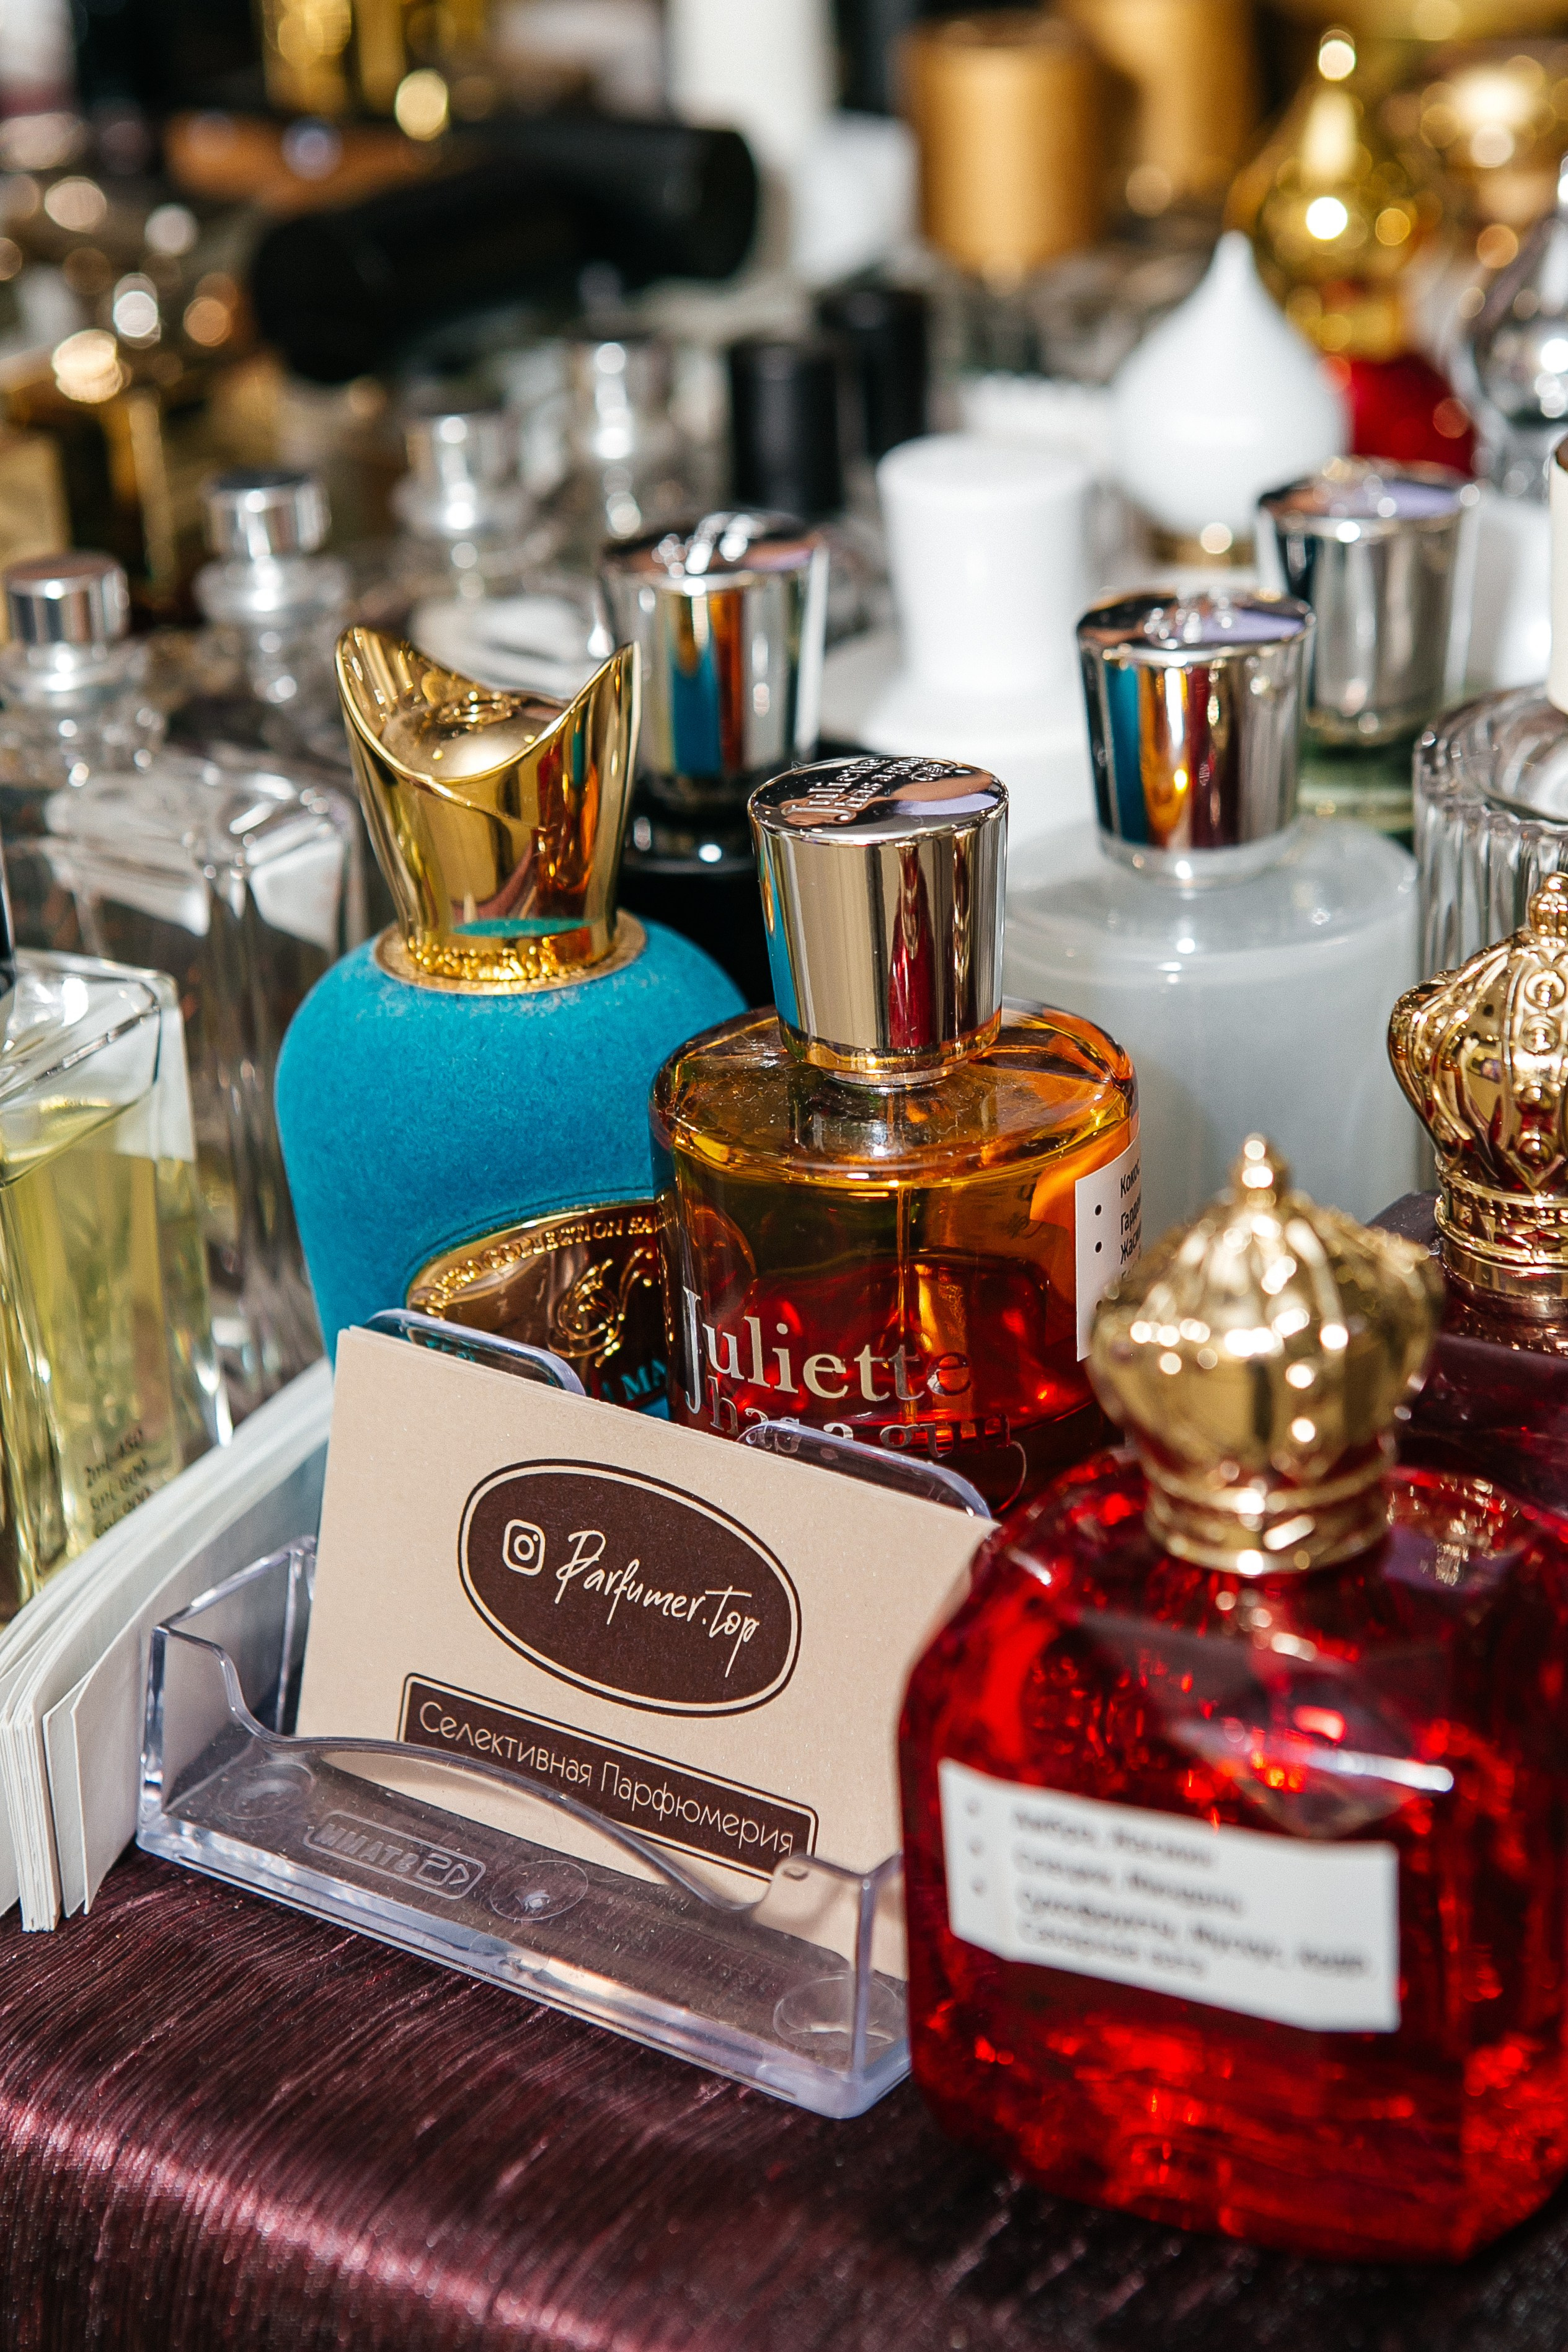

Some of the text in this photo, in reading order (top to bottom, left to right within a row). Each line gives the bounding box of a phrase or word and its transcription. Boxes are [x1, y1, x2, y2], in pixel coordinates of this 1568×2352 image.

[483, 1218, 622, 1269] COLLECTION
[682, 1286, 970, 1414] Juliette
[419, 1700, 794, 1857] Селективная Парфюмерия
